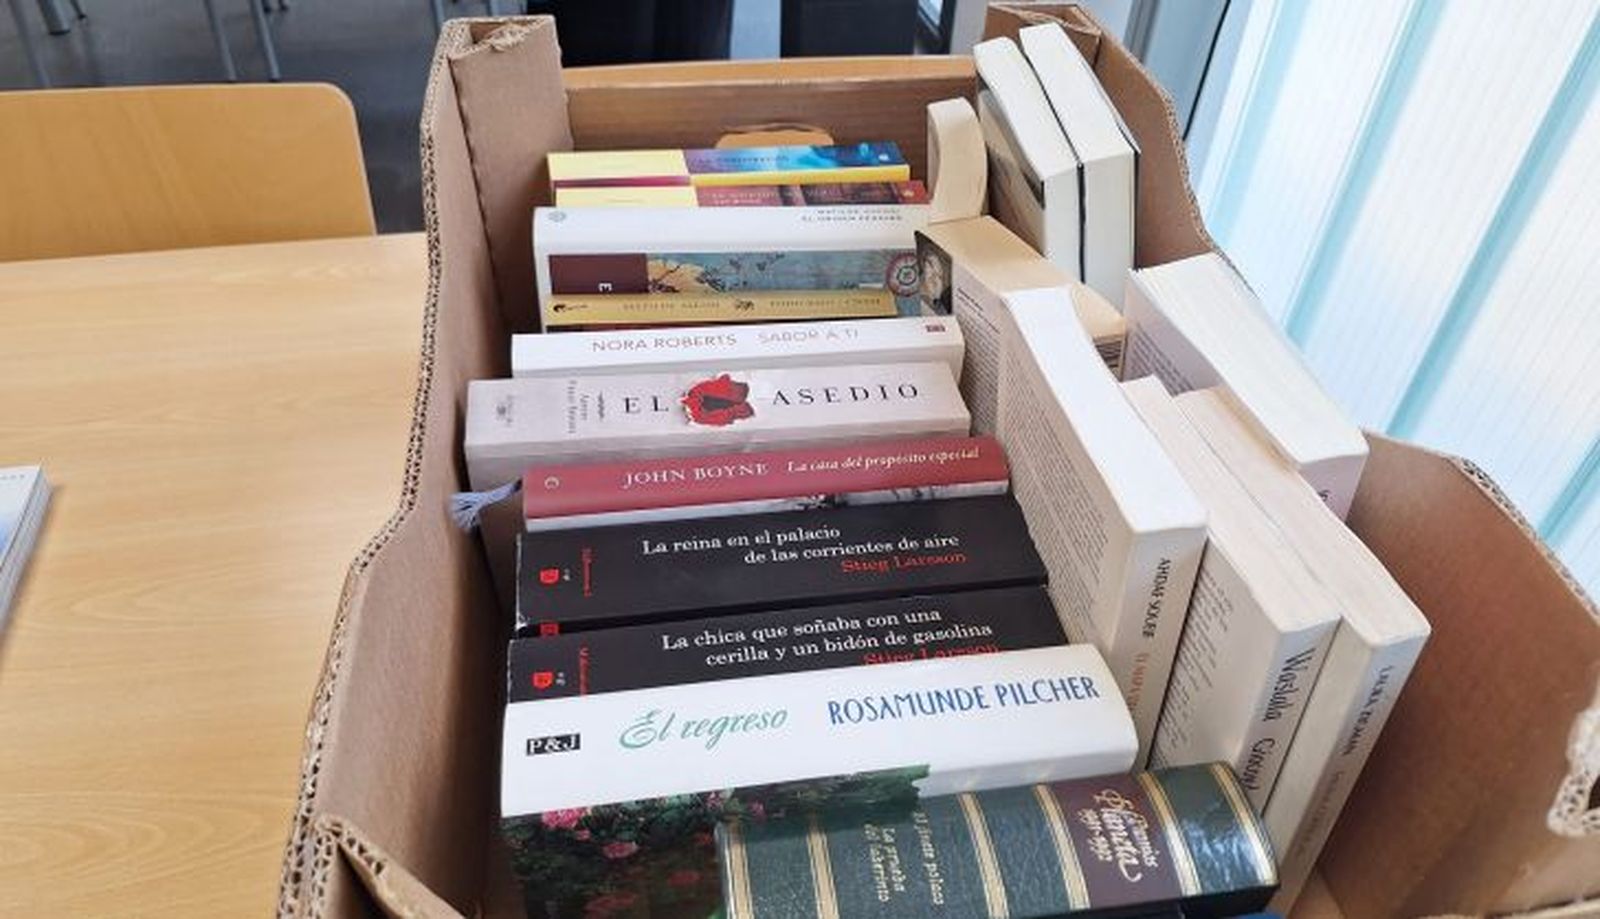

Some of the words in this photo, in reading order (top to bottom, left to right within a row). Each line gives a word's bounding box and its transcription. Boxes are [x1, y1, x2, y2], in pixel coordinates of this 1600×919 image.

[592, 339, 648, 352] NORA
[654, 334, 738, 348] ROBERTS
[758, 328, 816, 344] SABOR
[825, 328, 839, 340] A
[623, 395, 670, 415] EL
[772, 381, 920, 406] ASEDIO
[623, 472, 686, 489] JOHN
[694, 463, 769, 481] BOYNE
[787, 462, 808, 473] La
[841, 457, 862, 469] del
[928, 448, 981, 463] especial
[641, 540, 669, 556] La
[673, 538, 722, 551] reina
[726, 534, 751, 547] en
[755, 530, 772, 545] el
[776, 524, 842, 546] palacio
[744, 551, 767, 565] de
[772, 547, 799, 562] las
[803, 540, 893, 560] corrientes
[897, 536, 920, 550] de
[924, 534, 960, 547] aire
[841, 558, 889, 573] Stieg
[894, 553, 967, 569] Larsson
[662, 633, 689, 650] La
[694, 629, 747, 647] chica
[751, 627, 789, 644] que
[793, 618, 861, 637] soñaba
[866, 614, 899, 630] con
[904, 610, 942, 623] una
[705, 648, 769, 667] cerilla
[774, 647, 786, 659] y
[793, 643, 819, 656] un
[823, 632, 873, 651] bidón
[883, 629, 908, 646] de
[912, 624, 994, 644] gasolina
[827, 690, 992, 726] ROSAMUNDE
[998, 676, 1101, 708] PILCHER
[527, 734, 580, 756] P&J
[617, 708, 674, 751] El
[680, 708, 790, 752] regreso
